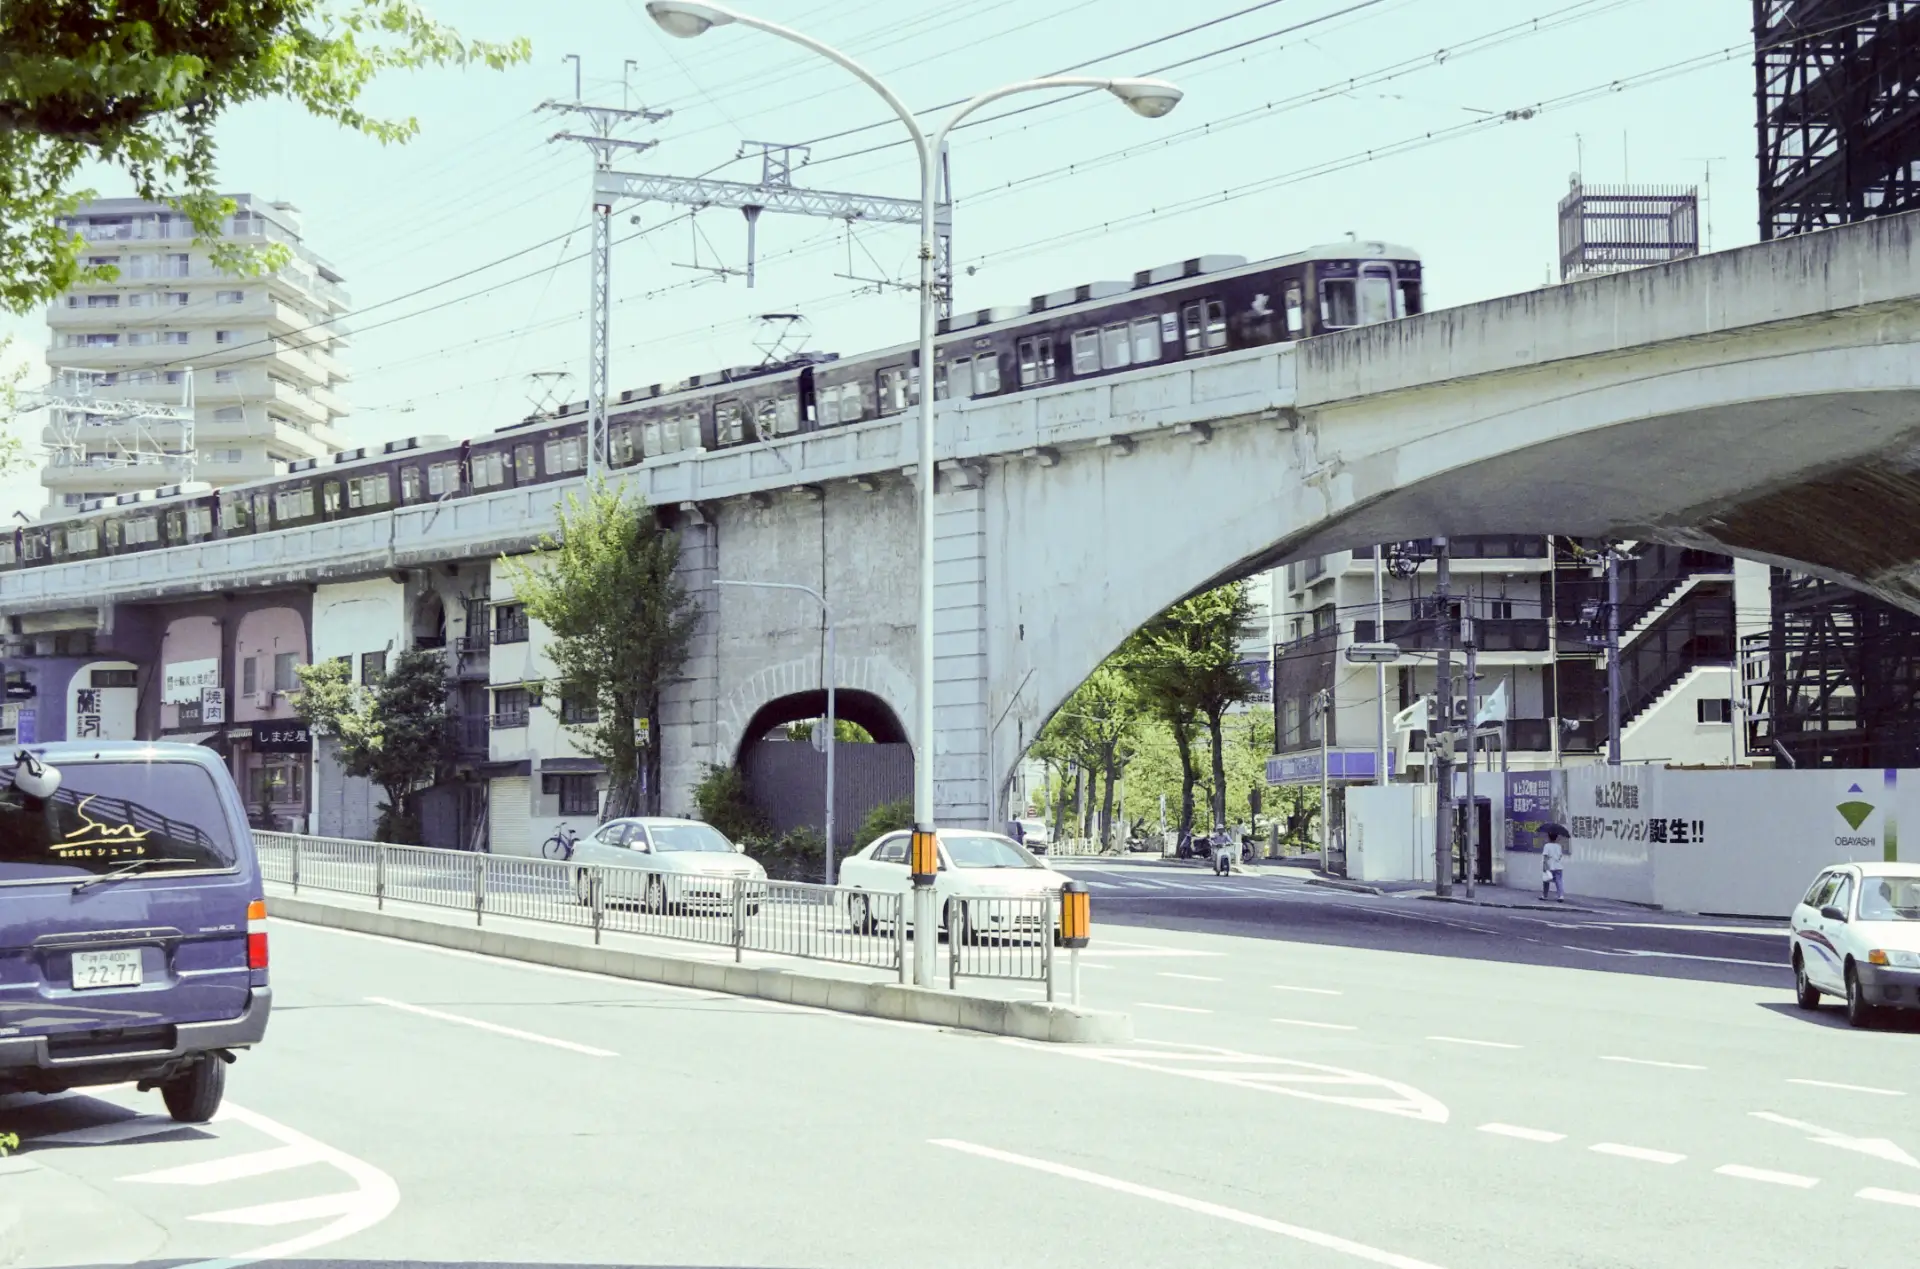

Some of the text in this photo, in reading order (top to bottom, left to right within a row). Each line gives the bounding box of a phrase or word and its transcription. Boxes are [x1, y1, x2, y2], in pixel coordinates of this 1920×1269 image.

[205, 690, 223, 720] 焼肉
[260, 730, 308, 743] しまだ屋
[1595, 781, 1639, 809] 地上32階建
[1834, 836, 1876, 846] OBAYASHI
[97, 846, 145, 856] シュール
